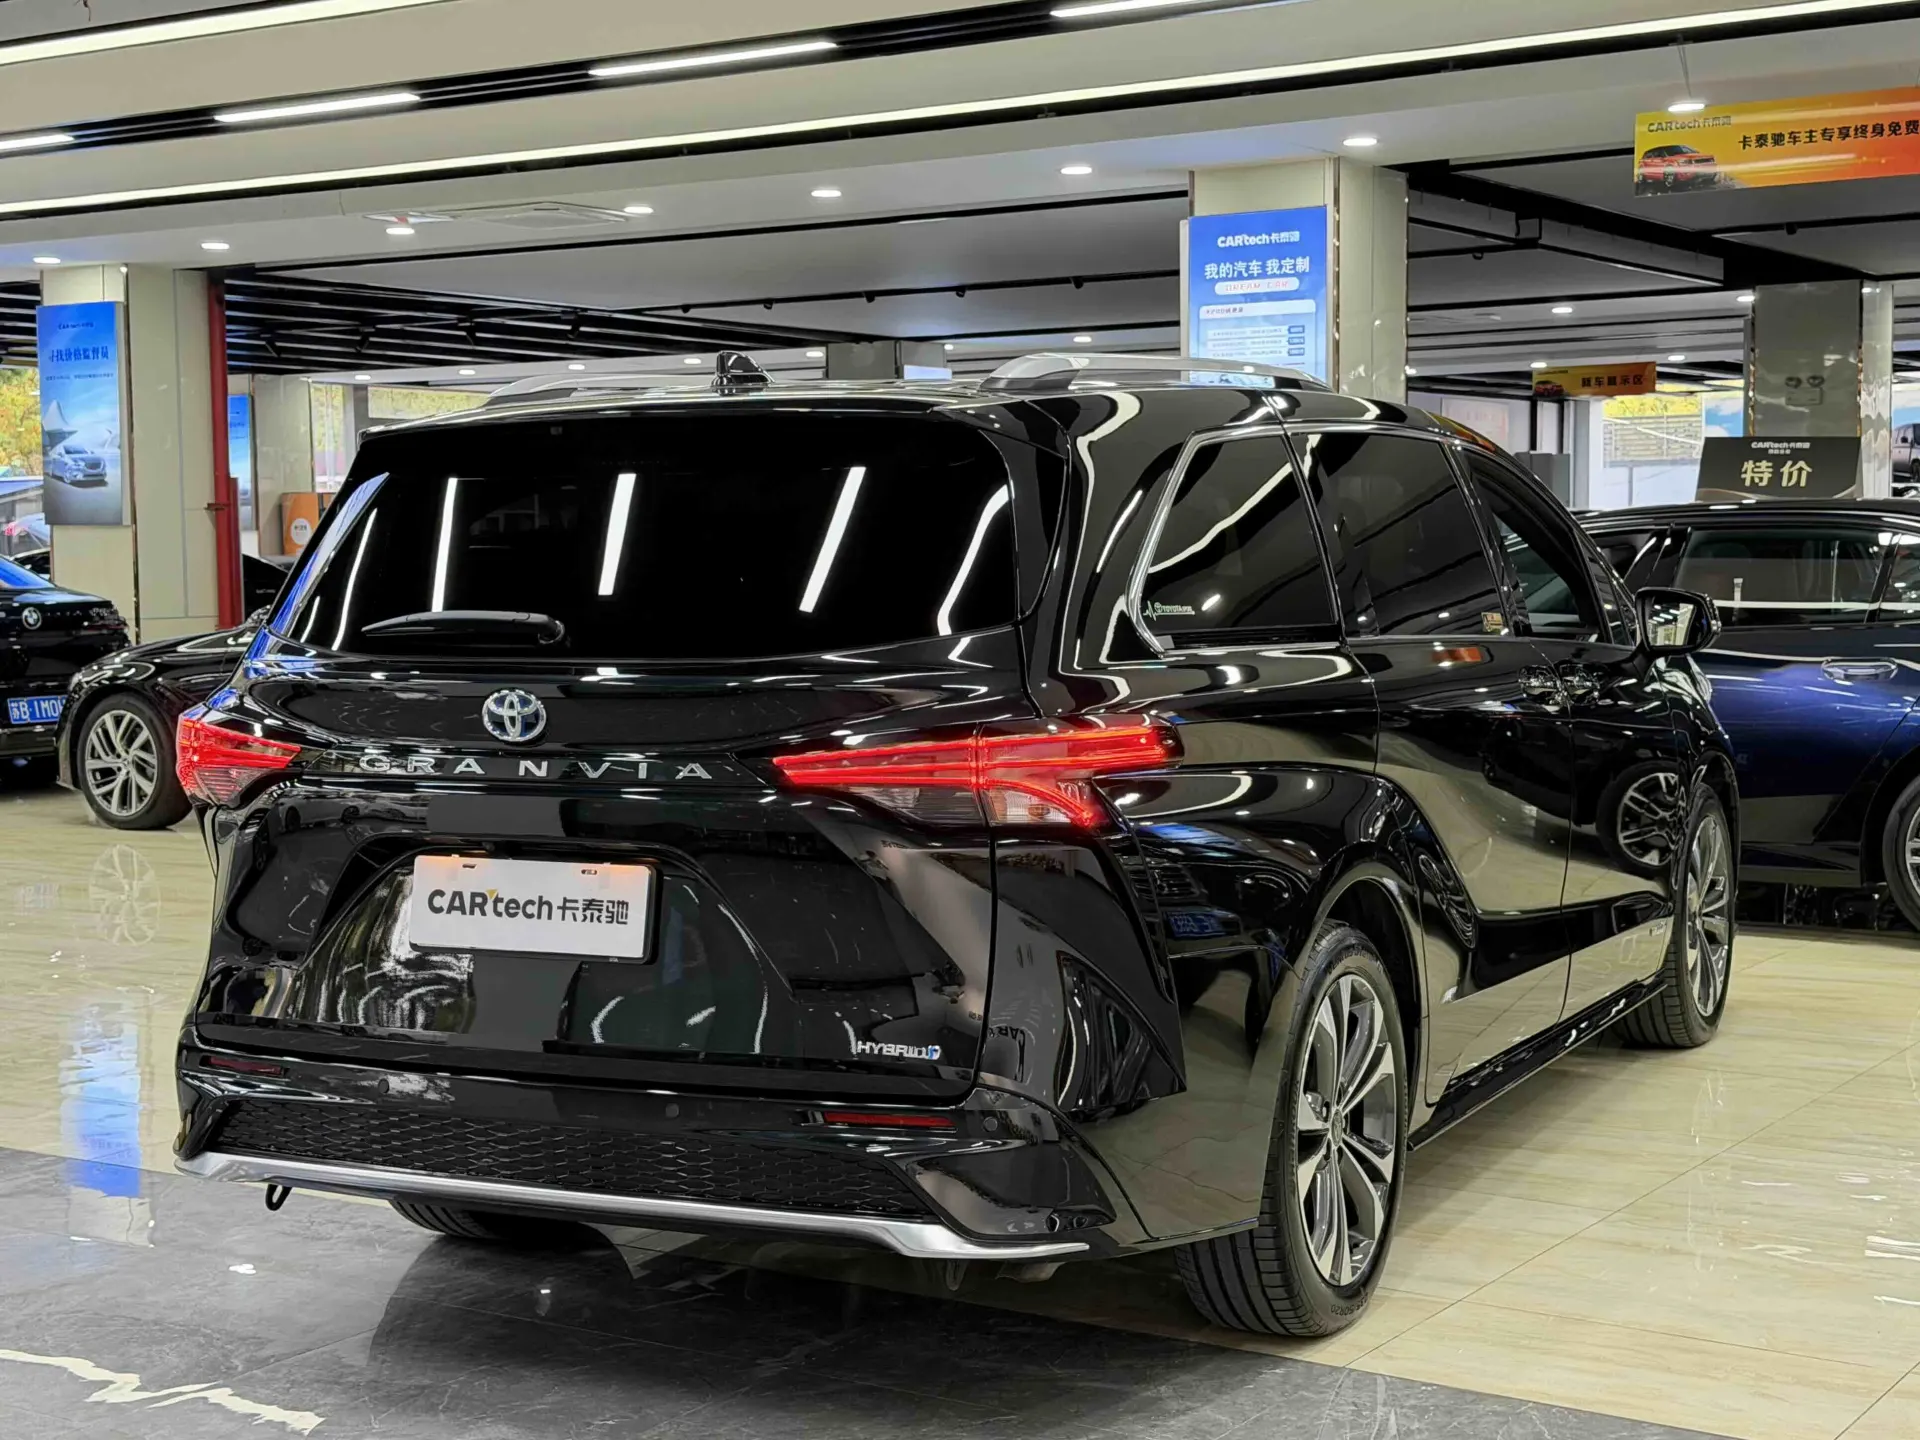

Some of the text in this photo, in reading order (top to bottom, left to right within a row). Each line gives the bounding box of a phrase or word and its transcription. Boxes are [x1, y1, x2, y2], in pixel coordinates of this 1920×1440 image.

[1738, 119, 1920, 150] 卡泰驰车主专享终身免费
[1204, 256, 1310, 280] 我的汽车 我定制
[1741, 460, 1812, 487] 特价
[359, 754, 712, 780] GRANVIA
[427, 889, 630, 926] CARtech 卡泰驰
[857, 1041, 928, 1060] HYBRID
